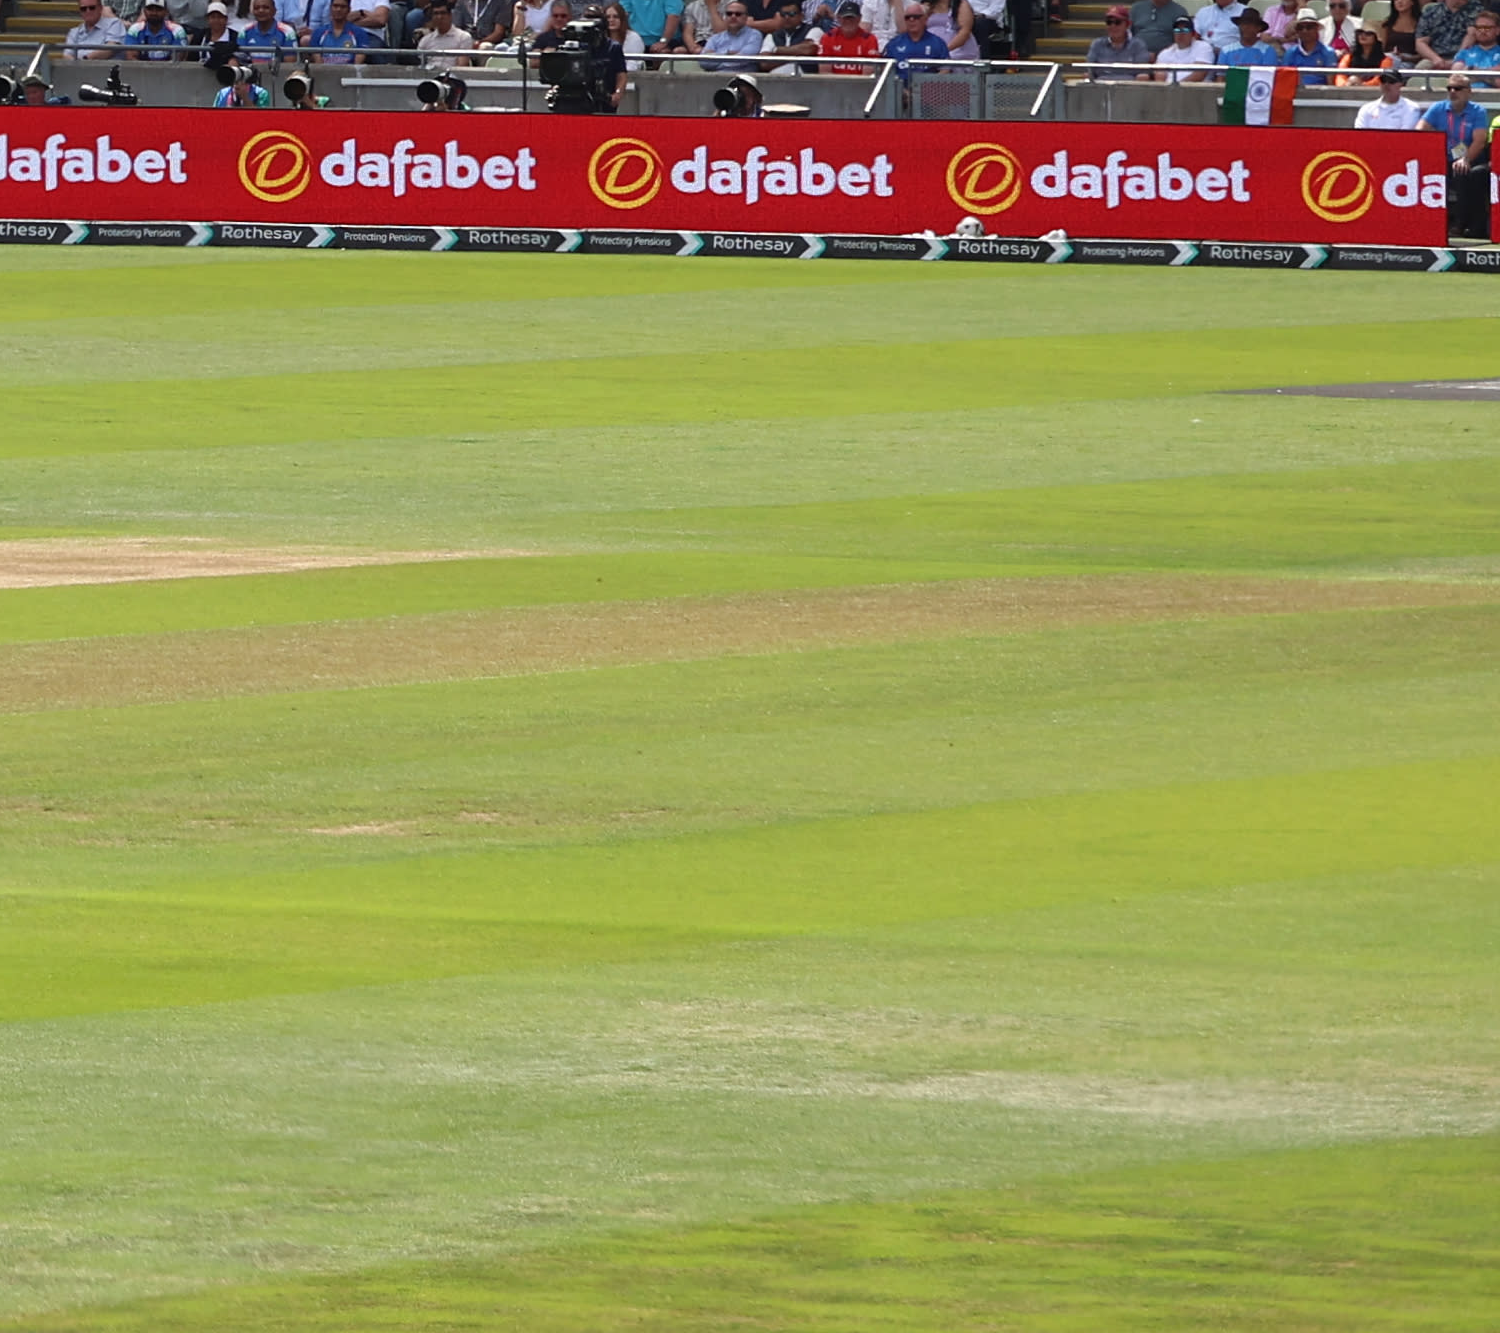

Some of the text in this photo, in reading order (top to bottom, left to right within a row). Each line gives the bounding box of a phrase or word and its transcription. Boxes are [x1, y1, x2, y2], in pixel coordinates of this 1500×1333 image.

[321, 139, 535, 197] dafabet
[671, 146, 892, 204] dafabet
[1031, 150, 1250, 208] dafabet
[98, 227, 182, 238] Protecting Pensions
[222, 226, 302, 243] Rothesay
[343, 231, 427, 243] Protecting Pensions
[469, 231, 550, 247] Rothesay
[713, 235, 793, 254] Rothesay
[959, 240, 1039, 259] Rothesay
[1210, 246, 1293, 263] Rothesay
